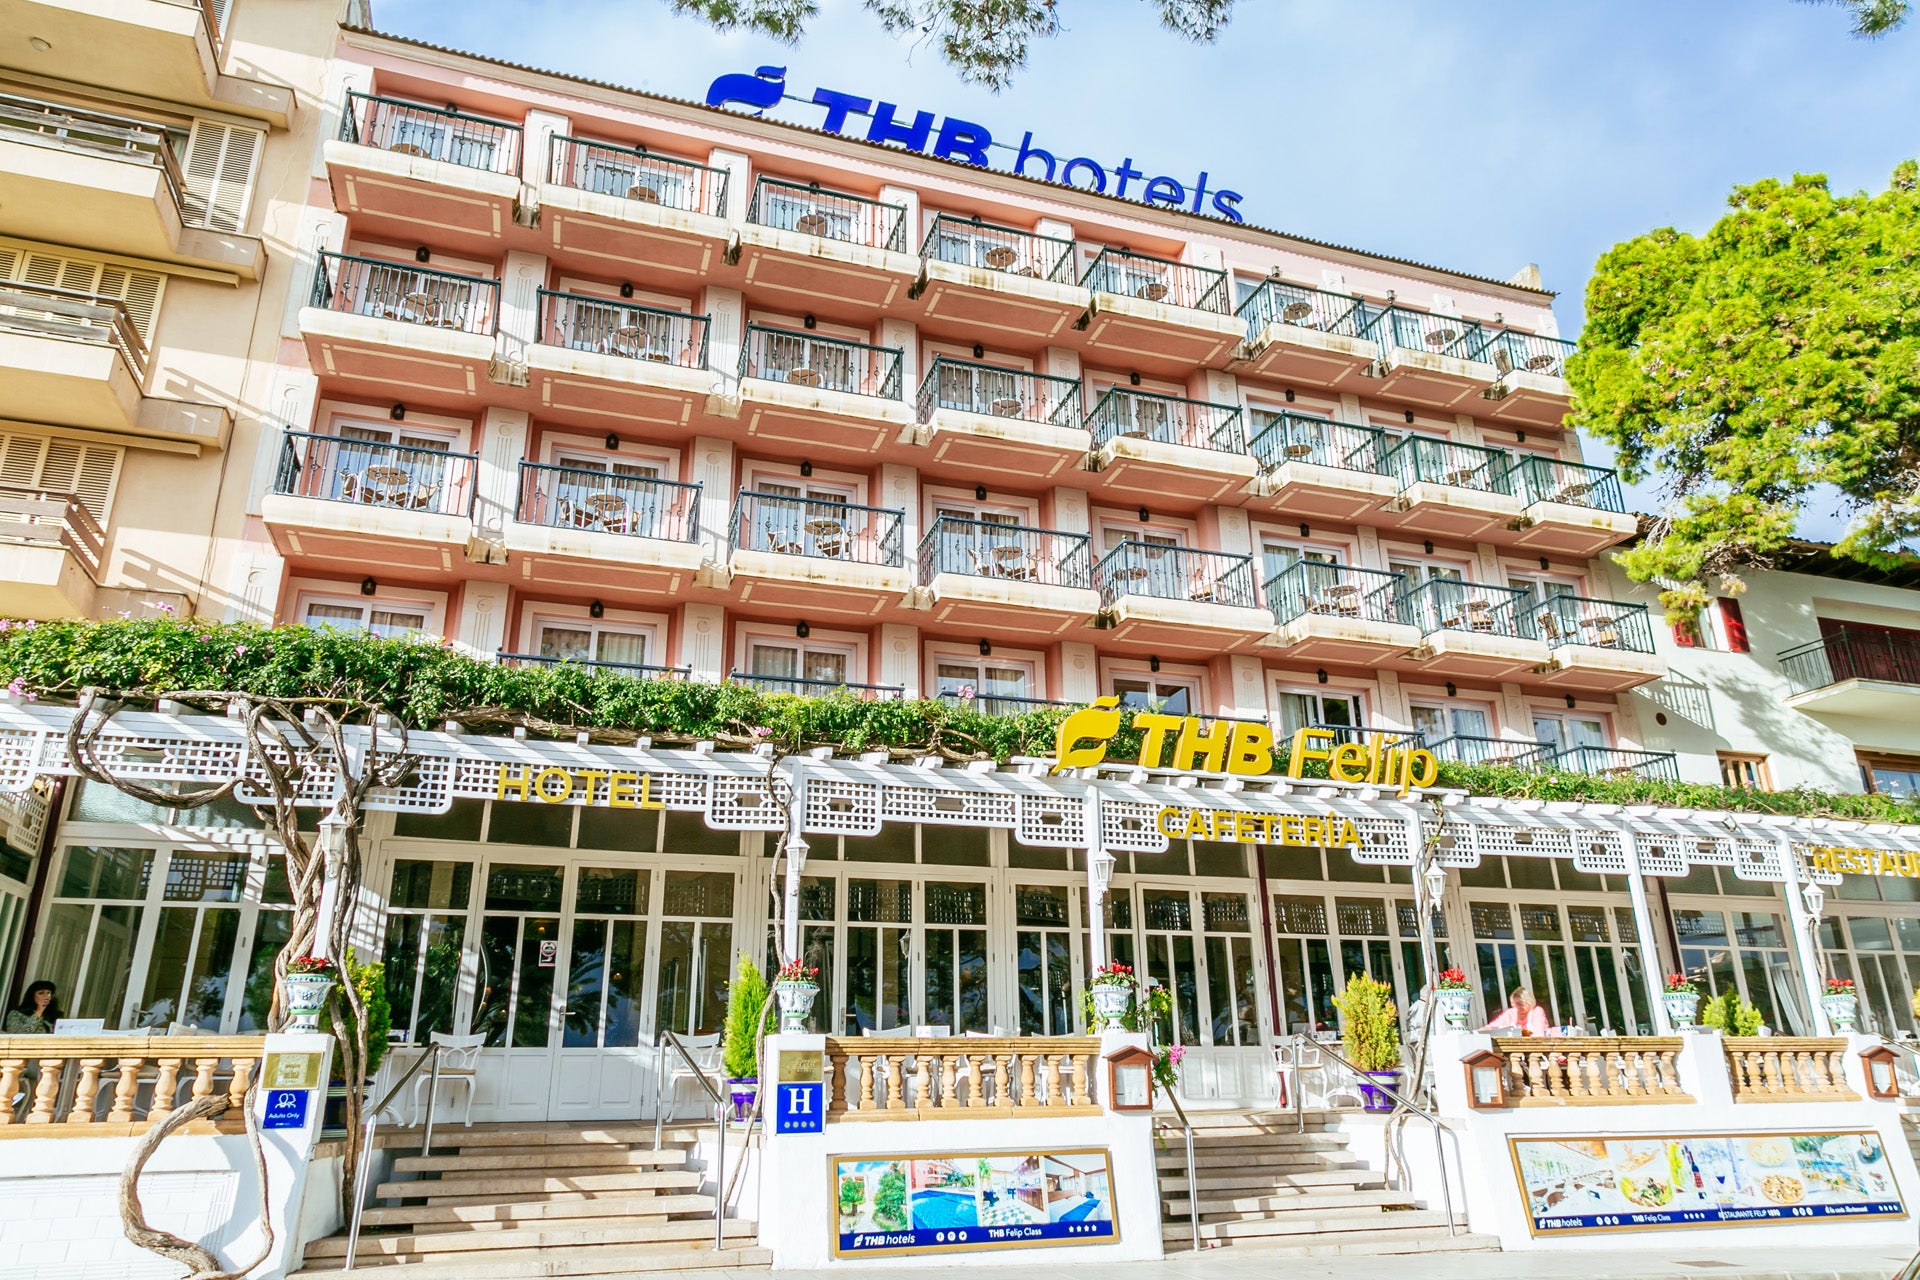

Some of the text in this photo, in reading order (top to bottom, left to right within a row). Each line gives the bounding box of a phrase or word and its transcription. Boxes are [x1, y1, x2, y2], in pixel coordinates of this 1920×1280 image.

[811, 86, 1245, 224] THB hotels
[1132, 713, 1440, 799] THB Felip
[497, 764, 666, 809] HOTEL
[1157, 807, 1364, 850] CAFETERÍA
[787, 1087, 814, 1114] H
[864, 1233, 916, 1246] THB hotels
[988, 1226, 1042, 1239] THB Felip Class
[1546, 1216, 1583, 1228] THB hotels
